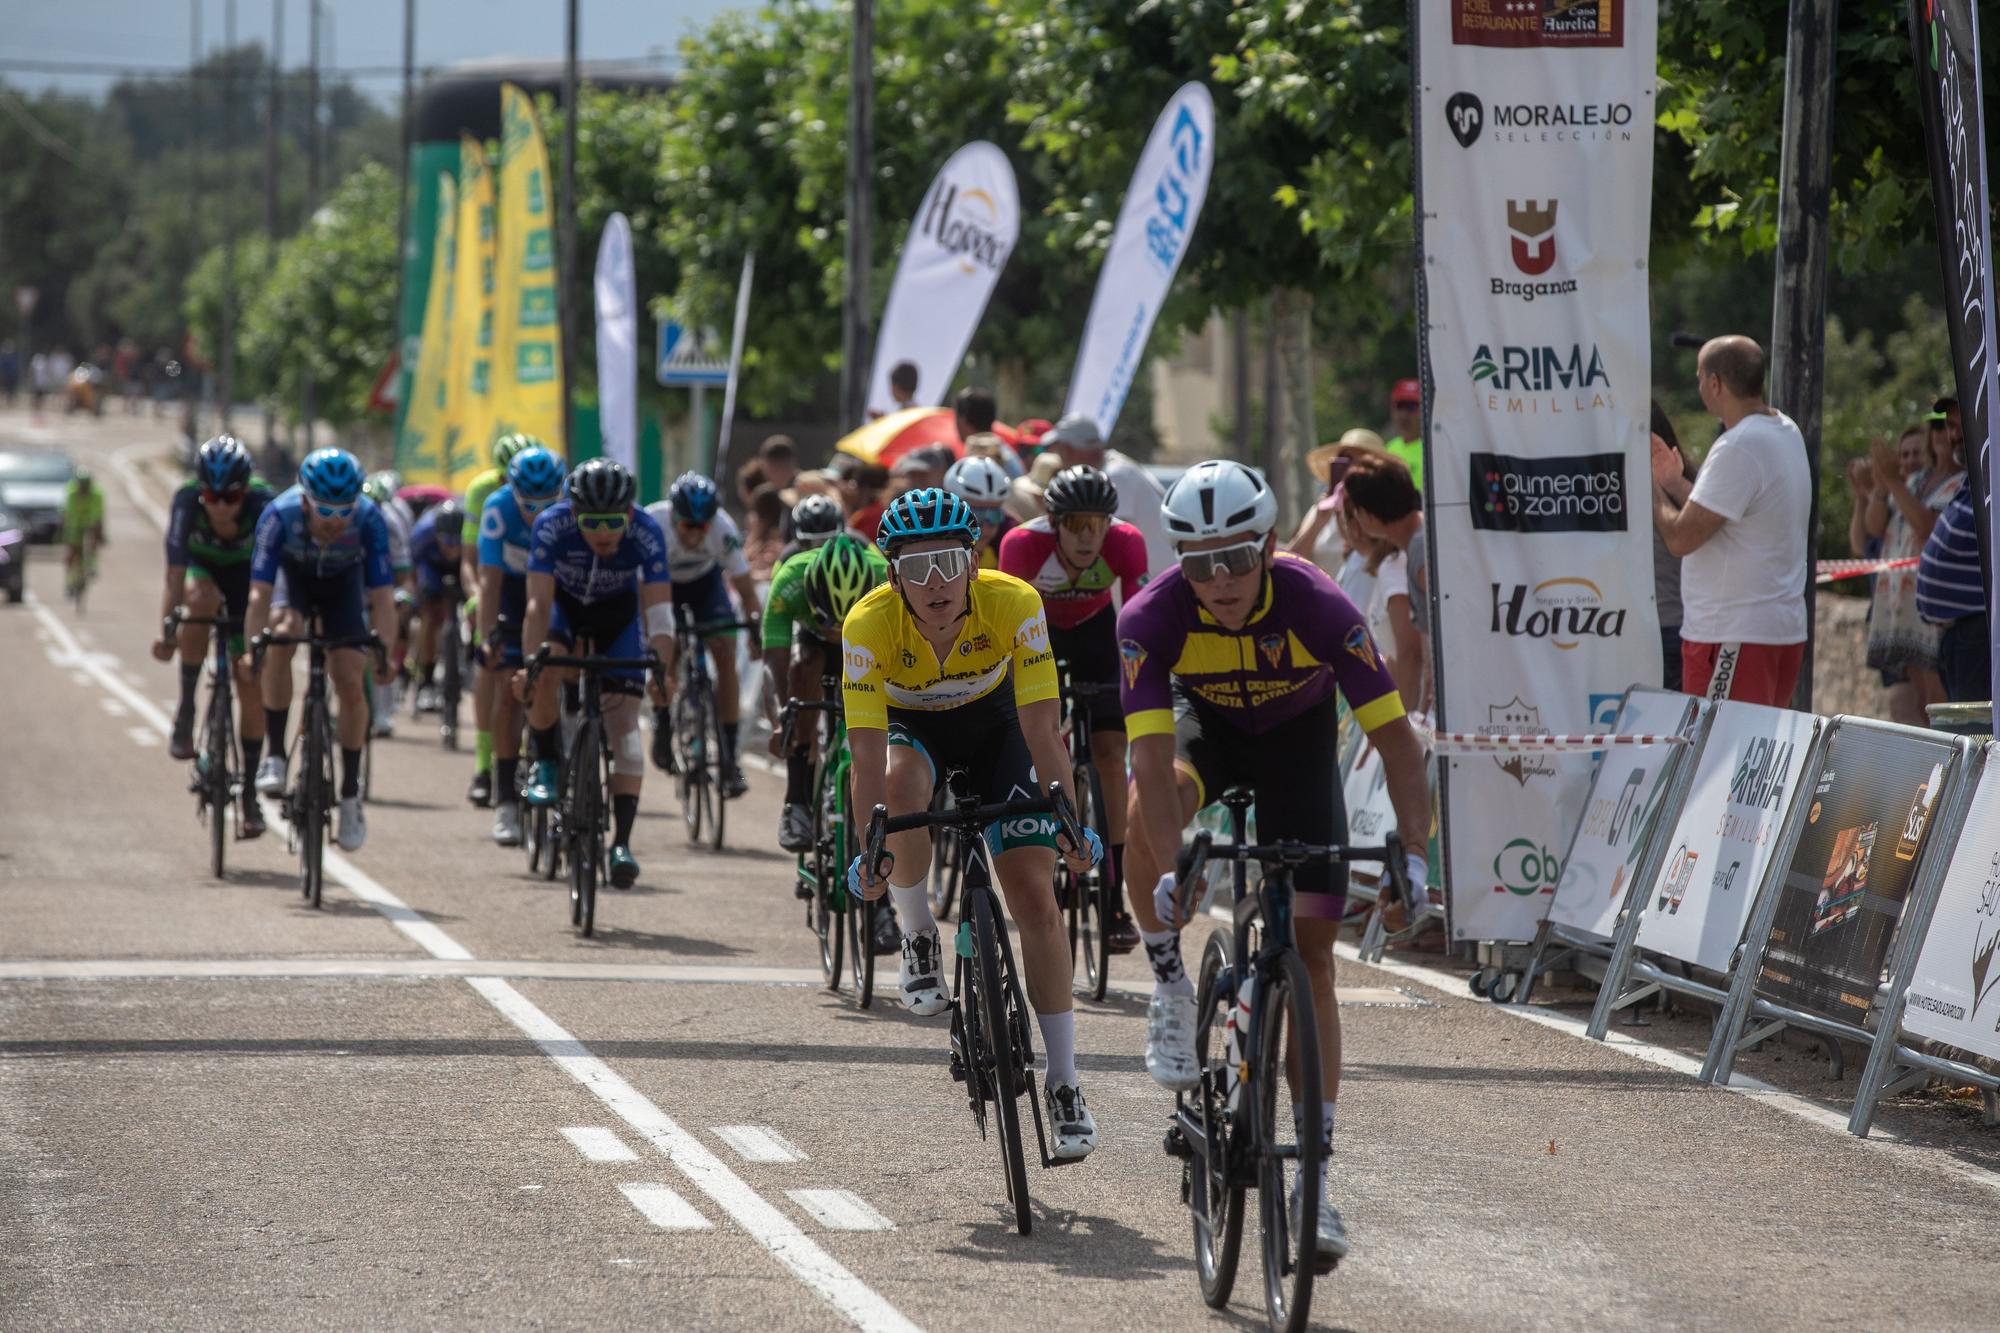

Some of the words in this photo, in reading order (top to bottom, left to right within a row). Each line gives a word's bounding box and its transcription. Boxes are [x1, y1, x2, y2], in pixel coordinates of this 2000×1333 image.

[1461, 14, 1537, 31] RESTAURANTE
[1543, 15, 1597, 31] Aurelia
[1568, 6, 1597, 16] Casa
[1494, 103, 1632, 127] MORALEJO
[1494, 130, 1631, 143] SELECCIÓN
[1490, 277, 1578, 302] Bragança
[1470, 343, 1611, 391] ARIMA
[1503, 470, 1621, 495] alimentos
[1525, 492, 1622, 516] zamora
[1490, 582, 1627, 638] Honza
[1730, 735, 1795, 812] ARIMA
